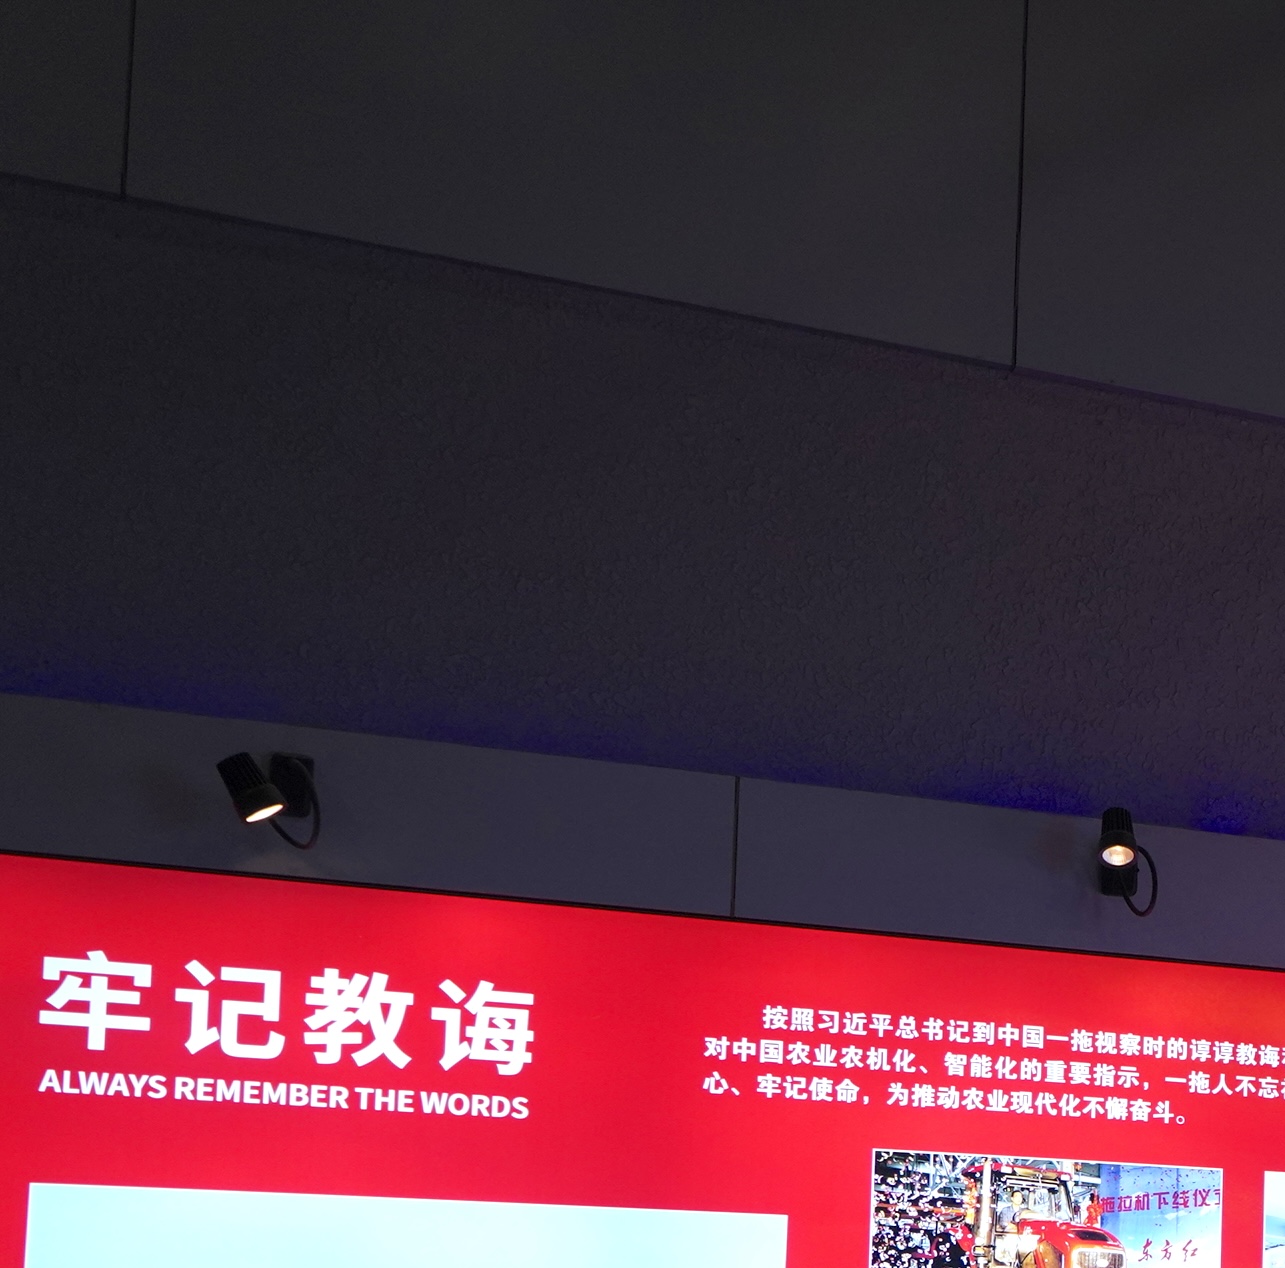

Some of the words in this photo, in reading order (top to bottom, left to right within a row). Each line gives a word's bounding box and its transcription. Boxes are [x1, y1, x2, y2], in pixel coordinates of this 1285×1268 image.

[38, 950, 535, 1076] 牢记教诲
[39, 1069, 167, 1099] ALWAYS
[174, 1076, 349, 1109] REMEMBER
[355, 1087, 415, 1113] THE
[420, 1091, 530, 1120] WORDS
[702, 1072, 1189, 1127] 心、牢记使命，为推动农业现代化不懈奋斗。
[1137, 1238, 1200, 1262] 东方红
